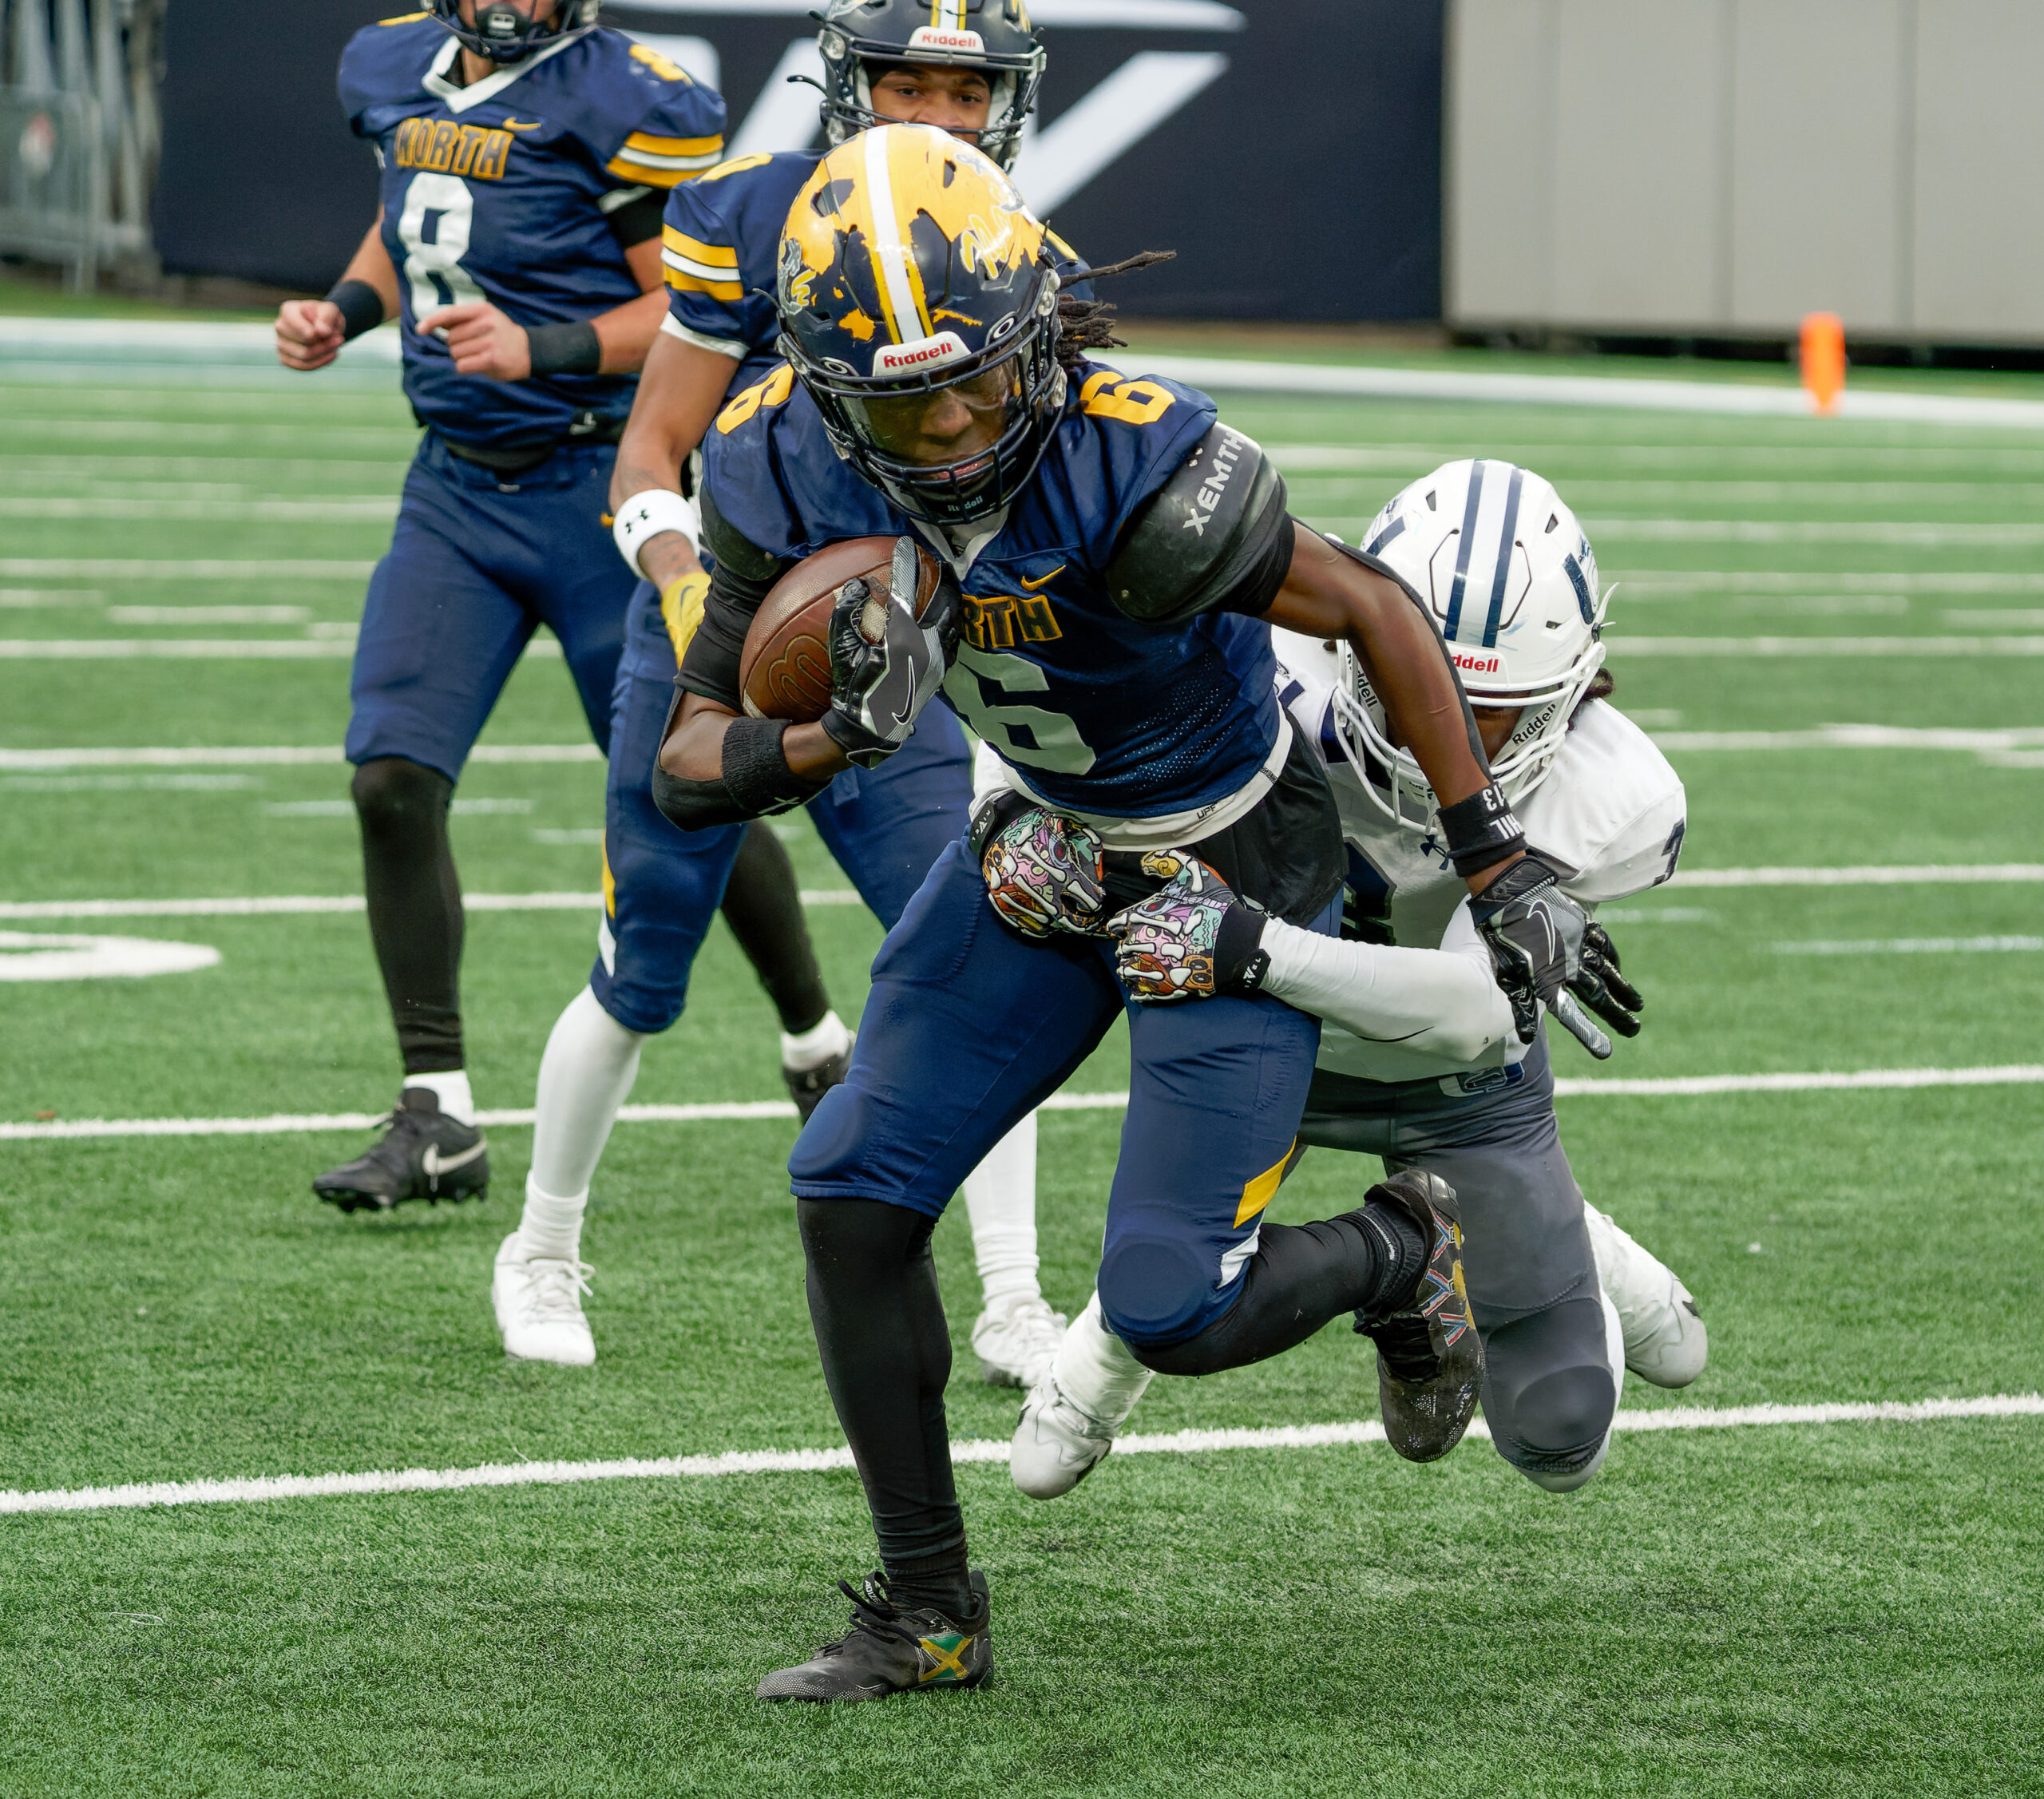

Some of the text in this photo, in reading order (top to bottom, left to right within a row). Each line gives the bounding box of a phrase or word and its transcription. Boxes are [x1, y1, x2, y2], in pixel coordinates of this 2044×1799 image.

[921, 34, 976, 47] Riddell
[394, 117, 514, 180] NORTH
[398, 172, 488, 341] 8
[883, 342, 953, 368] Riddell
[1080, 371, 1177, 425] 6
[961, 594, 1063, 648] RTH
[1452, 654, 1499, 672] ddell
[942, 639, 1097, 776] 6
